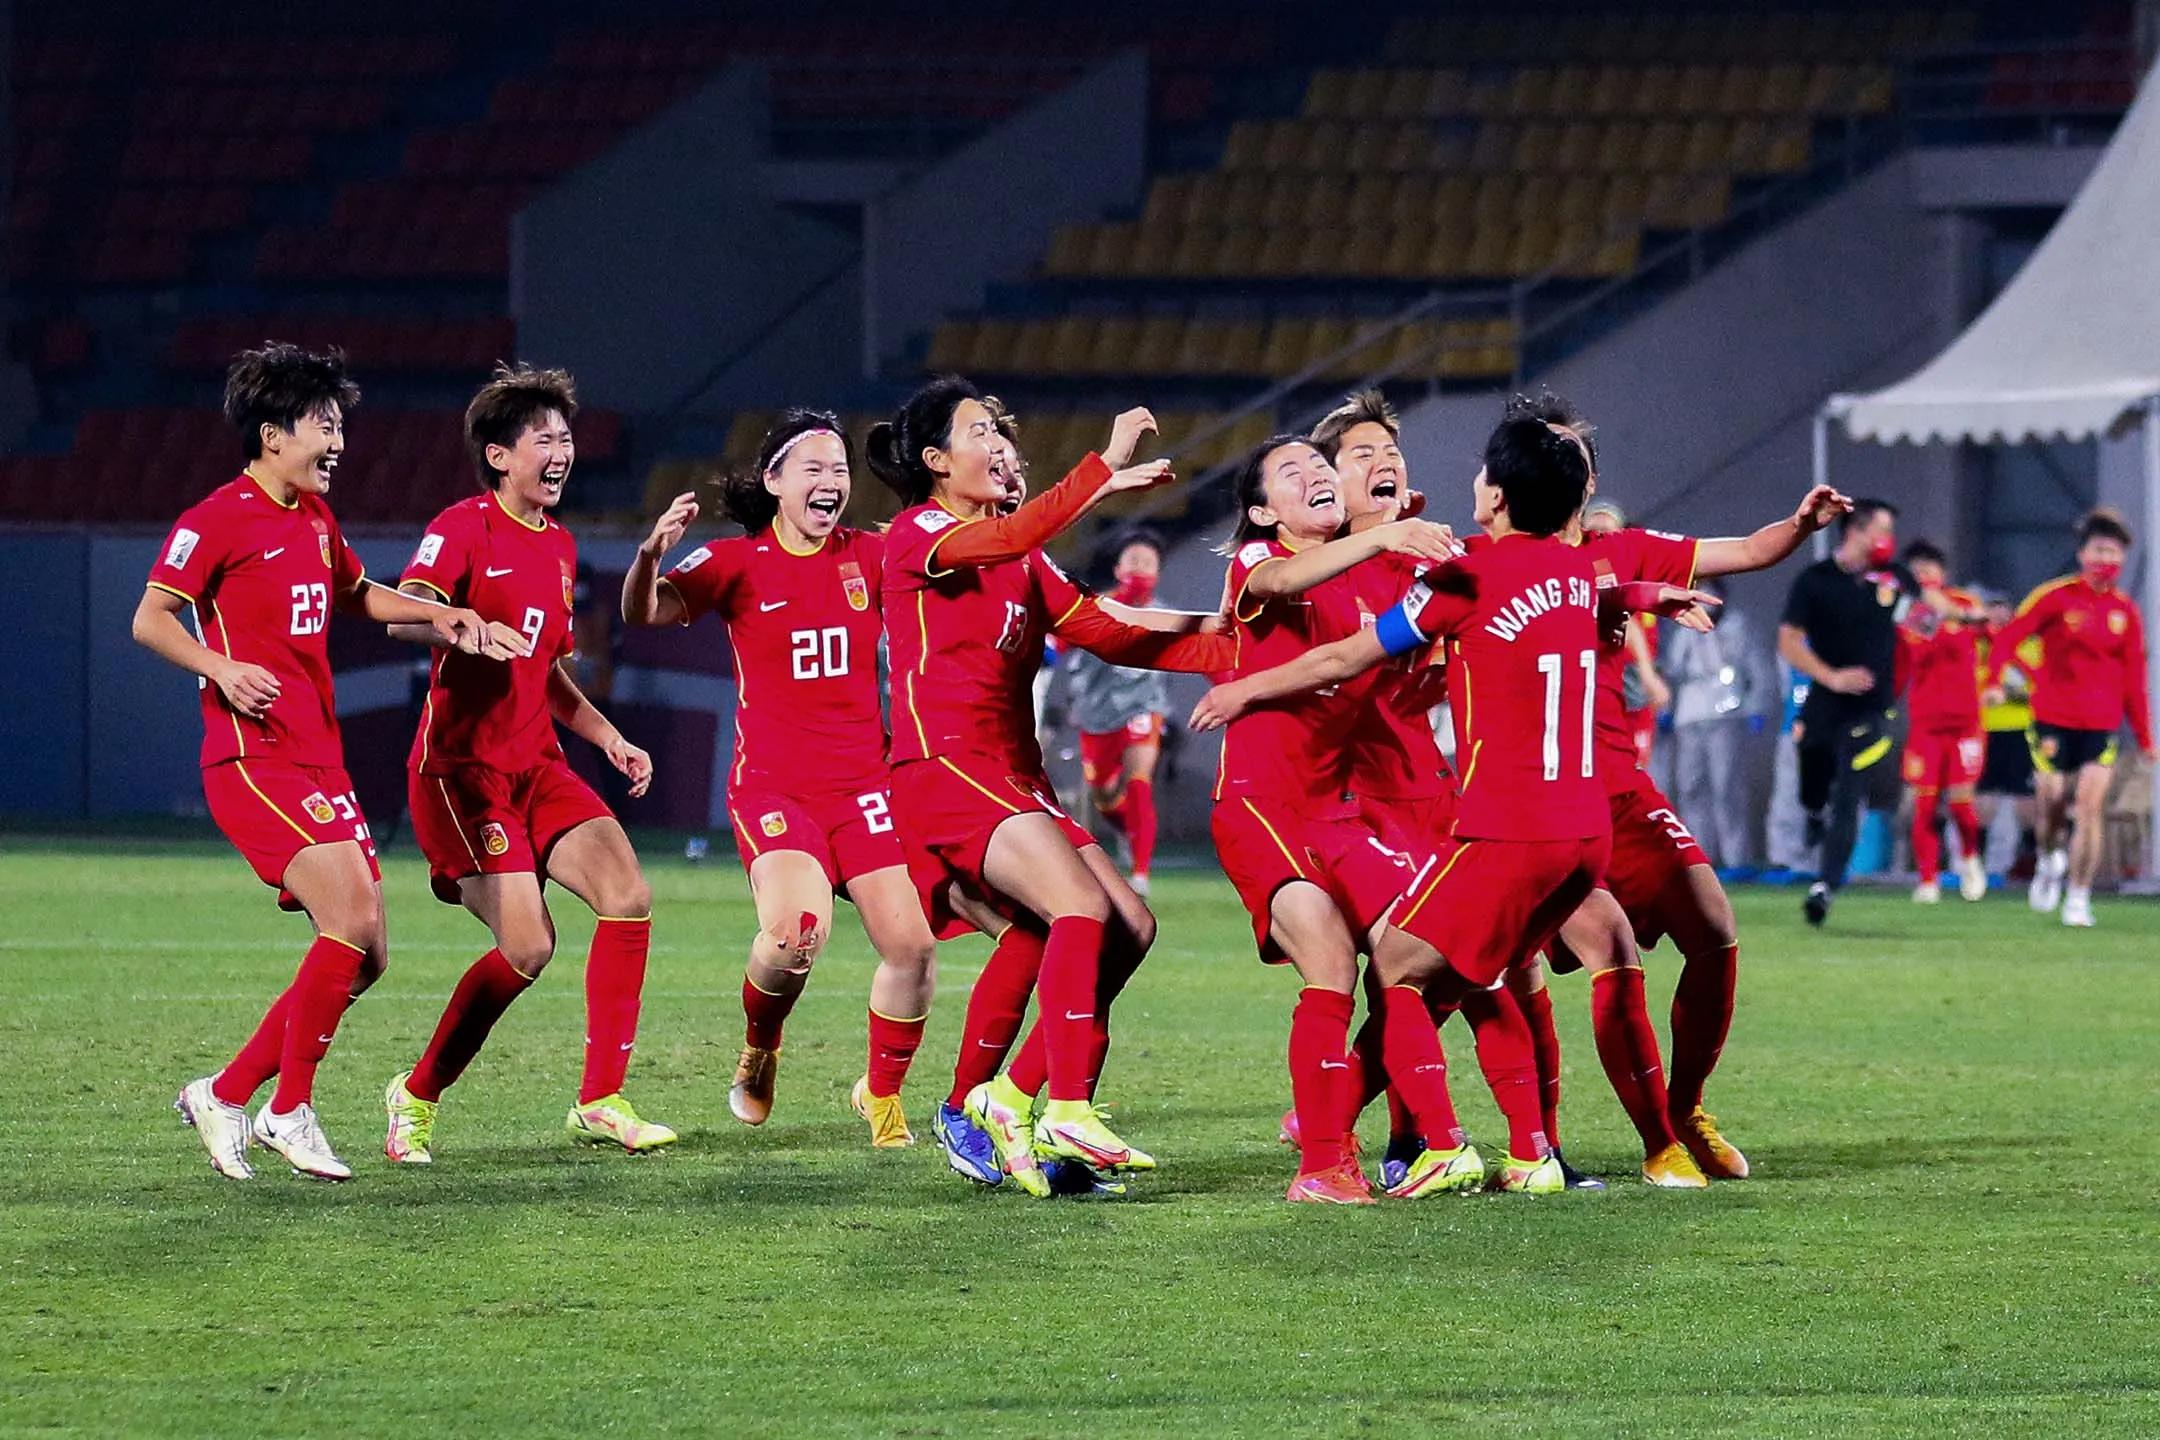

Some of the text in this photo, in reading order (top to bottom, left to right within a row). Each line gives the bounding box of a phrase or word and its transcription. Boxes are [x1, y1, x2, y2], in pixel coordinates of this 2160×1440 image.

[290, 583, 327, 635] 23
[522, 607, 545, 657] 9
[1485, 578, 1562, 642] WANG
[1568, 577, 1598, 618] SH
[791, 627, 848, 679] 20
[1538, 650, 1596, 781] 11
